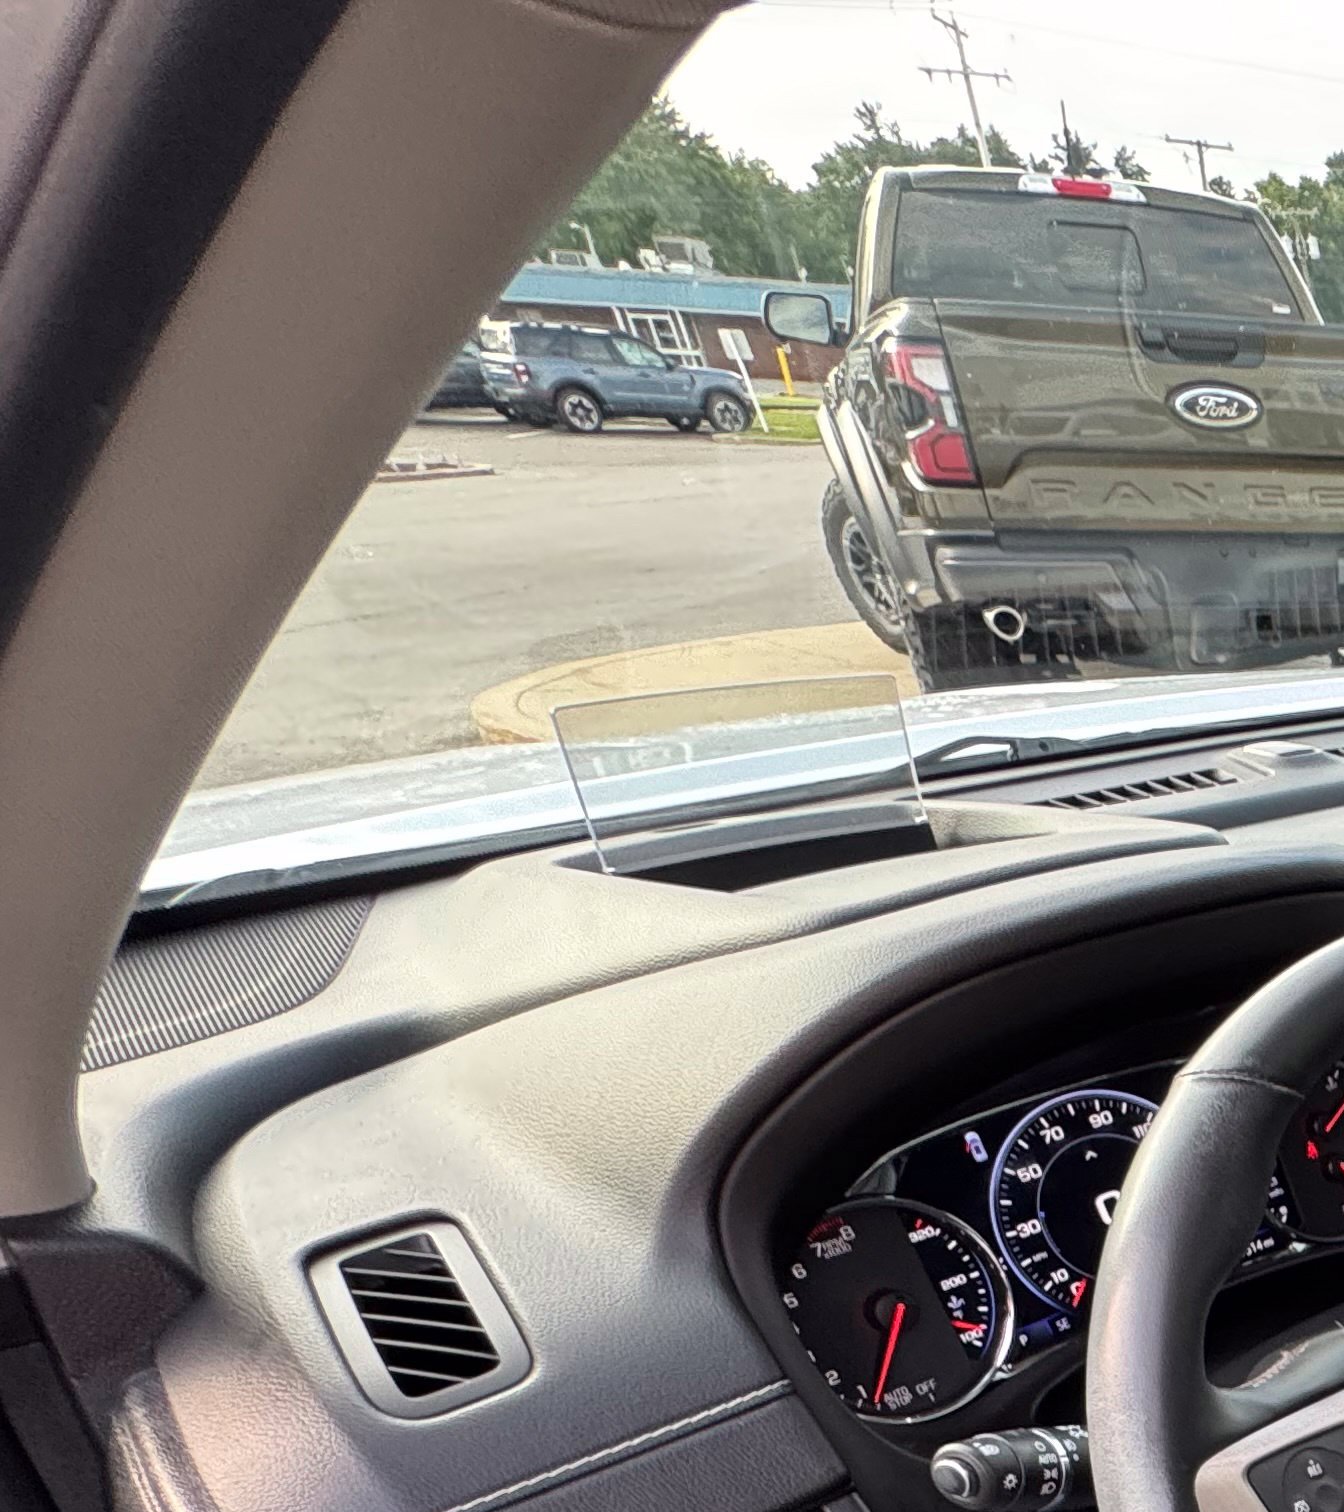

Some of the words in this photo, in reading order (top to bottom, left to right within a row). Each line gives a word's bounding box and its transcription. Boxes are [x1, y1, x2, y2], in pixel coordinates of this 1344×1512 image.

[1195, 395, 1239, 419] Ford
[1088, 1110, 1113, 1127] 90
[1039, 1126, 1064, 1145] 70
[1017, 1164, 1042, 1182] 50
[840, 1225, 856, 1241] 8
[1017, 1219, 1042, 1238] 30
[810, 1243, 822, 1258] 7
[792, 1264, 807, 1279] 6
[1050, 1268, 1069, 1284] 10
[783, 1293, 799, 1309] 5
[825, 1370, 841, 1385] 2
[884, 1386, 909, 1402] AUTO
[916, 1378, 936, 1395] OFF
